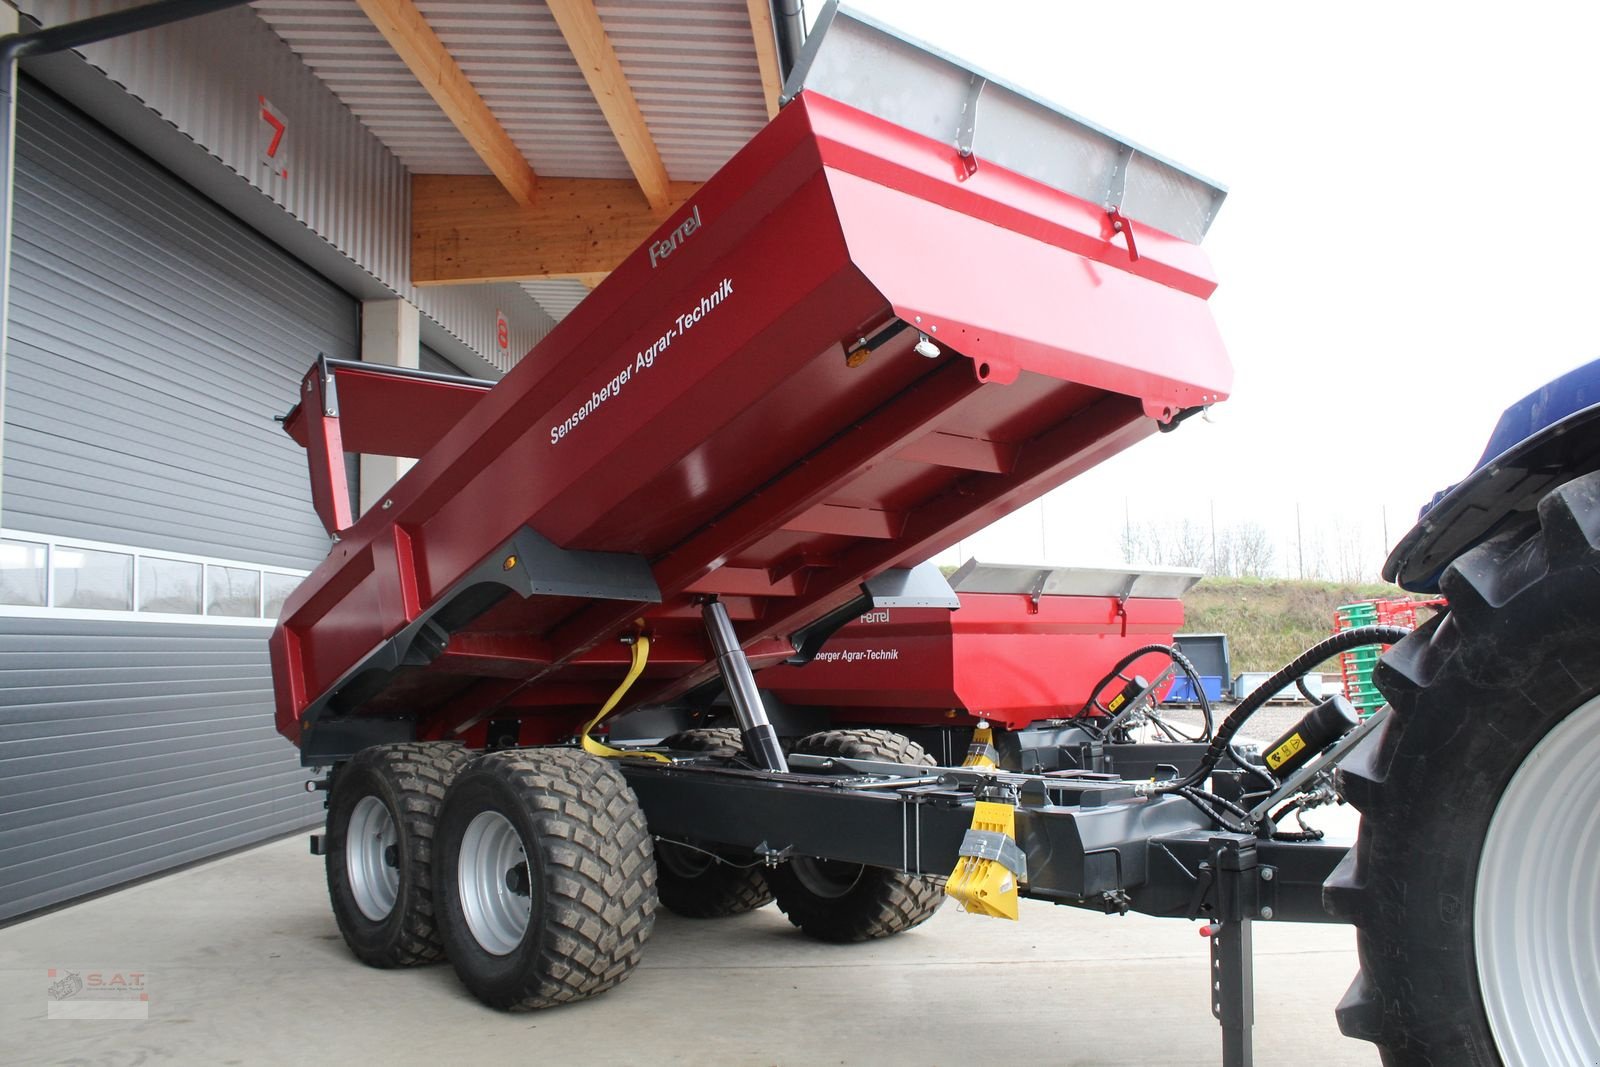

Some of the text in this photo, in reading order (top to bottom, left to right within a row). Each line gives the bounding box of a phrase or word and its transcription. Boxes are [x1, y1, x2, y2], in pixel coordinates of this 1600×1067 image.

[261, 108, 285, 159] 7
[648, 204, 702, 269] Ferrel
[498, 319, 509, 349] 8
[550, 277, 734, 446] Sensenberger Agrar-Technik
[814, 649, 898, 662] berger Agrar-Technik
